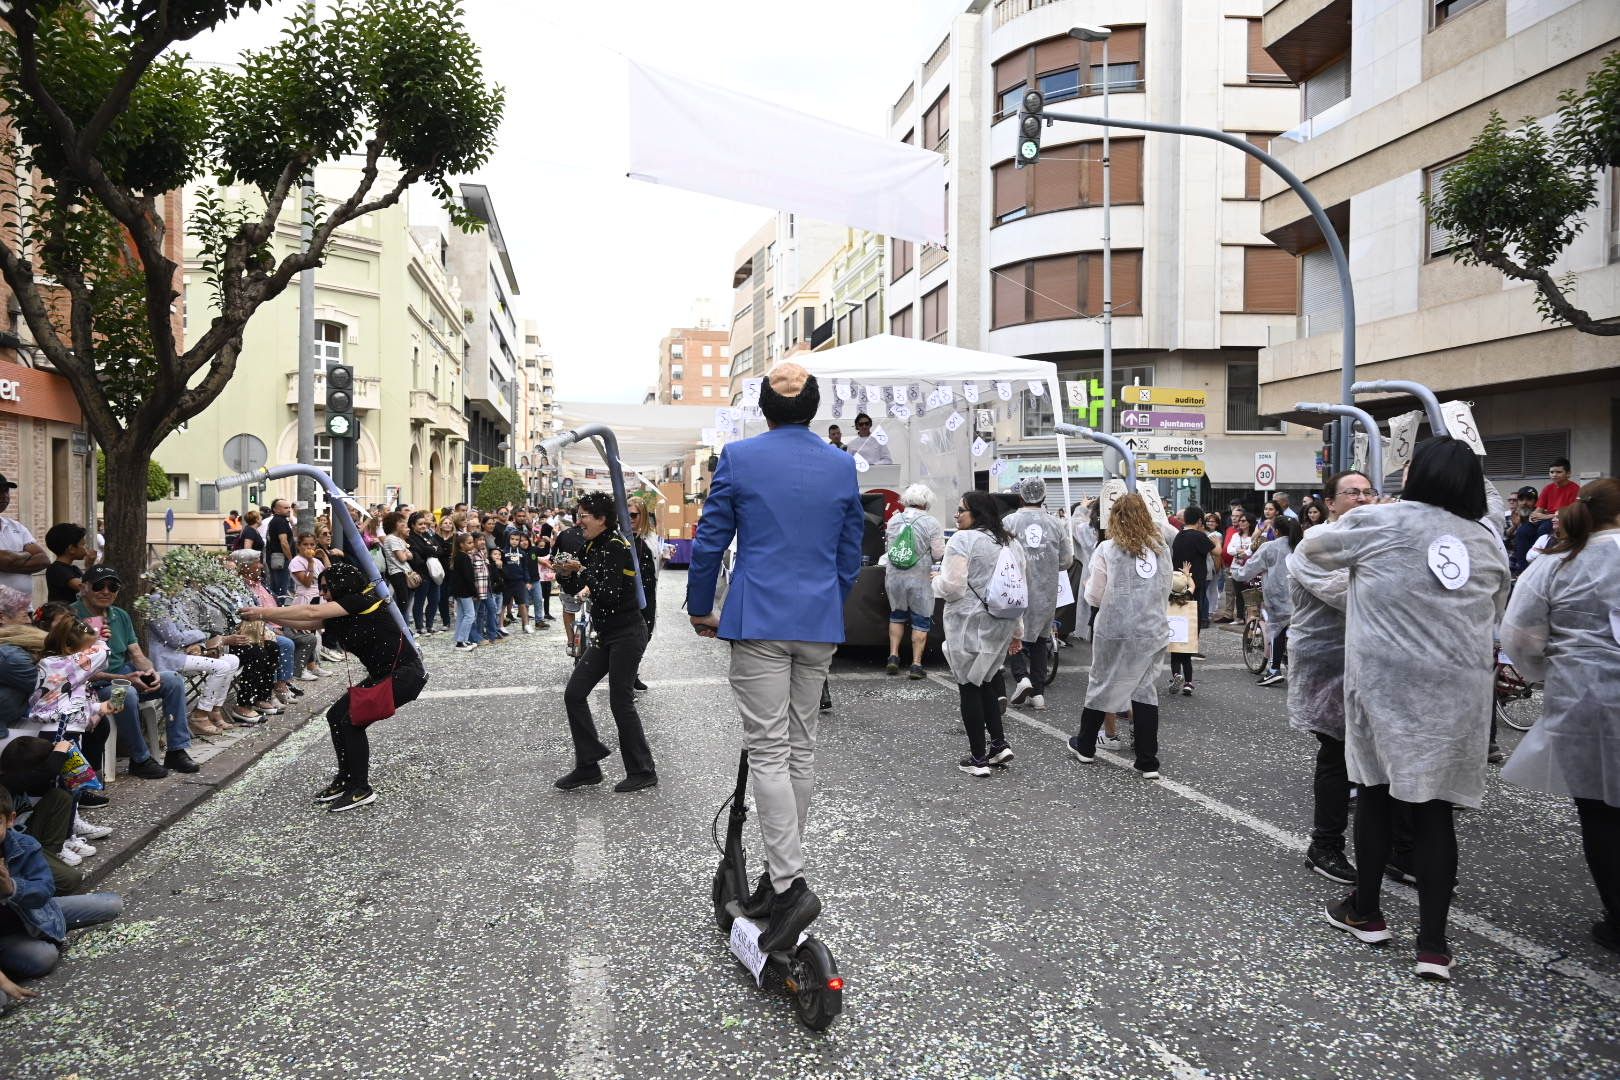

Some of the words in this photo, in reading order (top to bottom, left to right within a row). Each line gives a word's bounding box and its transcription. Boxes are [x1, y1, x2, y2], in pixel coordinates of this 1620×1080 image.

[1175, 397, 1204, 405] auditori
[1160, 420, 1203, 428] ajuntament
[1184, 438, 1203, 446] totes
[1163, 445, 1203, 453] direccions
[1259, 471, 1271, 479] 30
